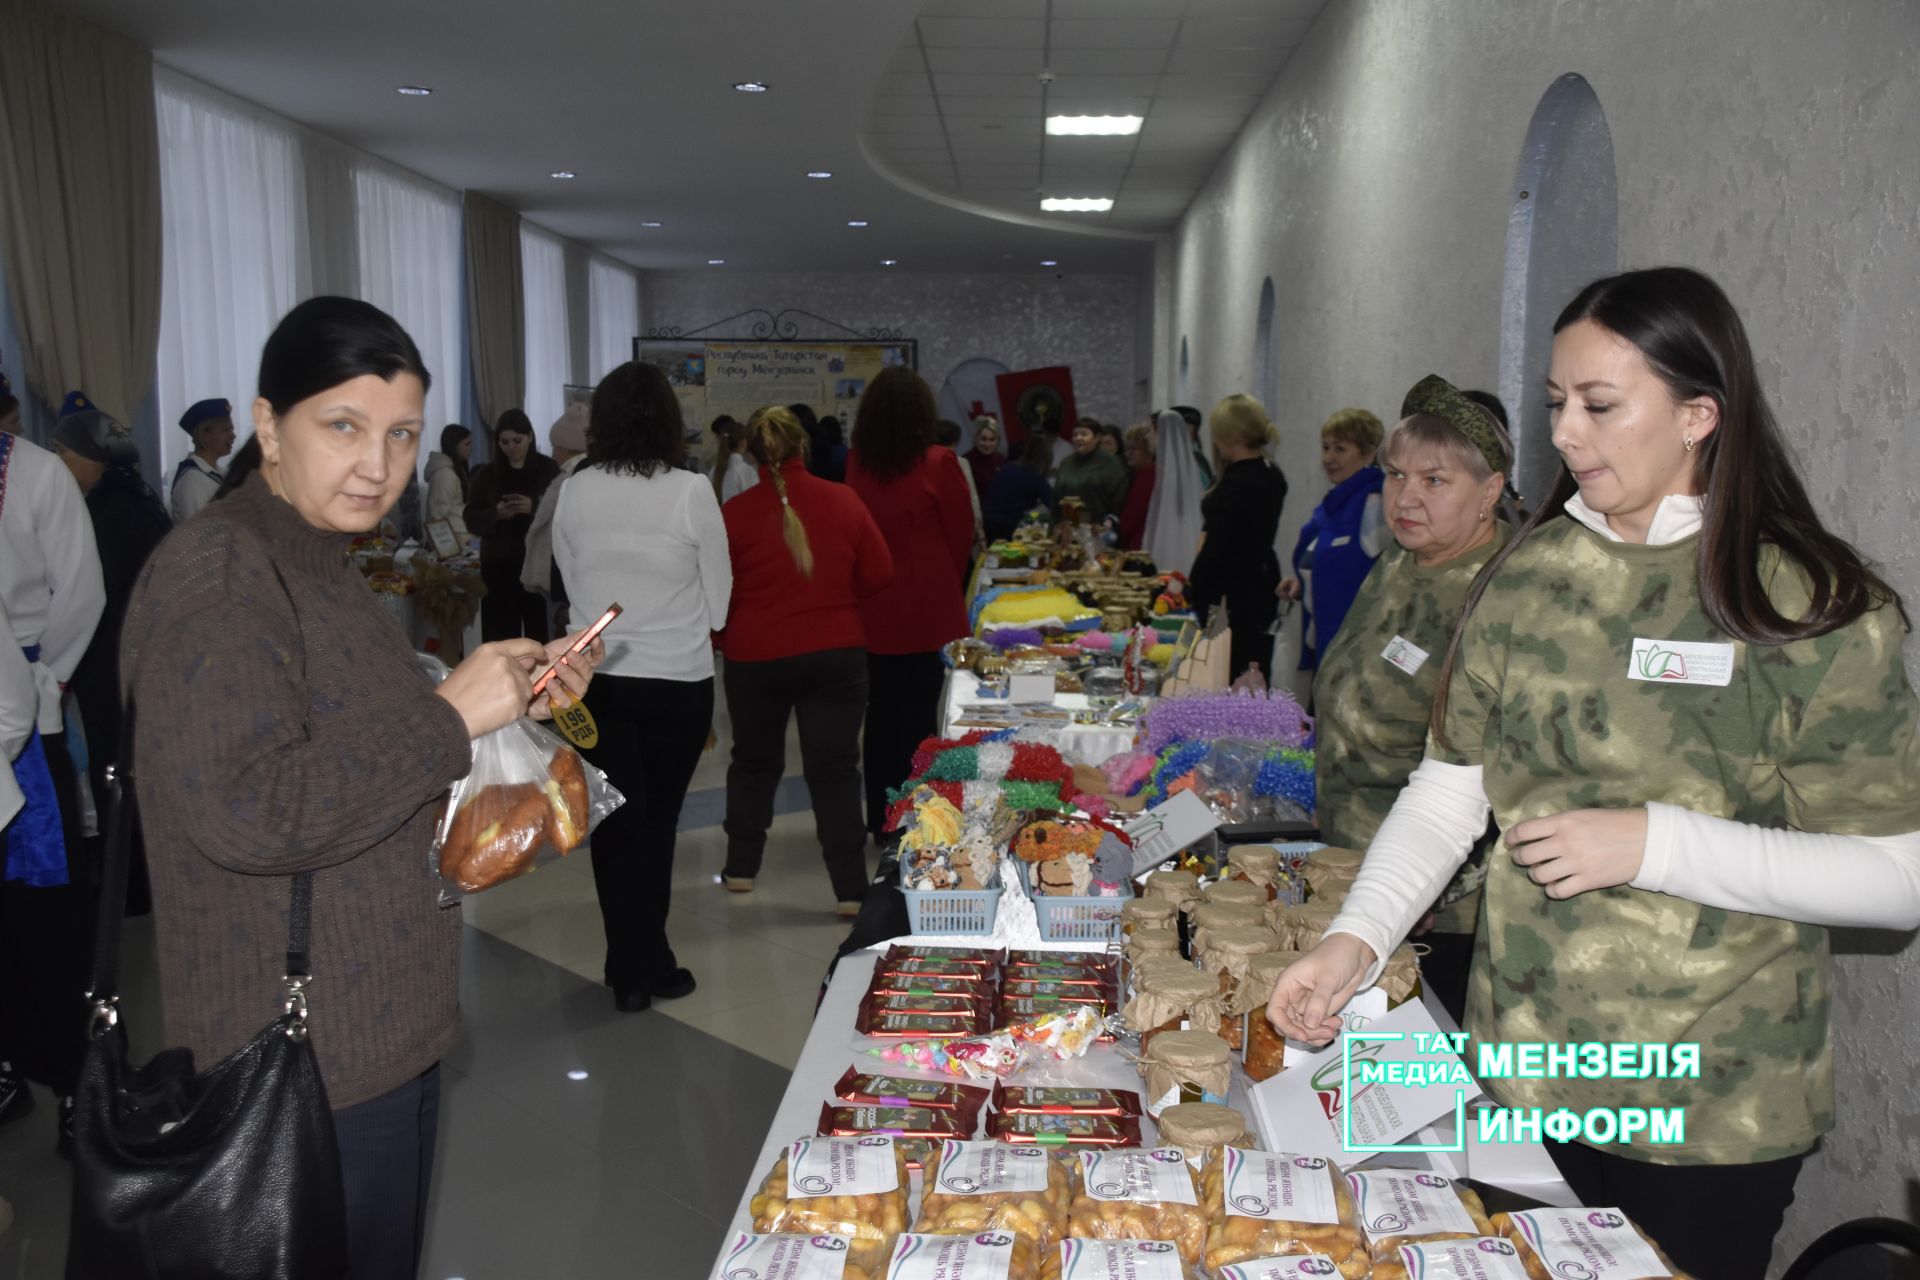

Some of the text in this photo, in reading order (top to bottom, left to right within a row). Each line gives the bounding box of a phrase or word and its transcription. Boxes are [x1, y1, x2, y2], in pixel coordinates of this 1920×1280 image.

[773, 349, 828, 362] Татарстан
[717, 363, 816, 378] город Мензелинск
[560, 708, 586, 730] 196
[572, 723, 595, 741] РДК
[955, 1240, 969, 1260] ЯРДӘМ
[1558, 1217, 1605, 1272] ПОМОЩЬ РЯДОМ!
[1446, 1248, 1468, 1277] ПОМОЩЬ
[1464, 1249, 1483, 1270] ЯРДӘМ
